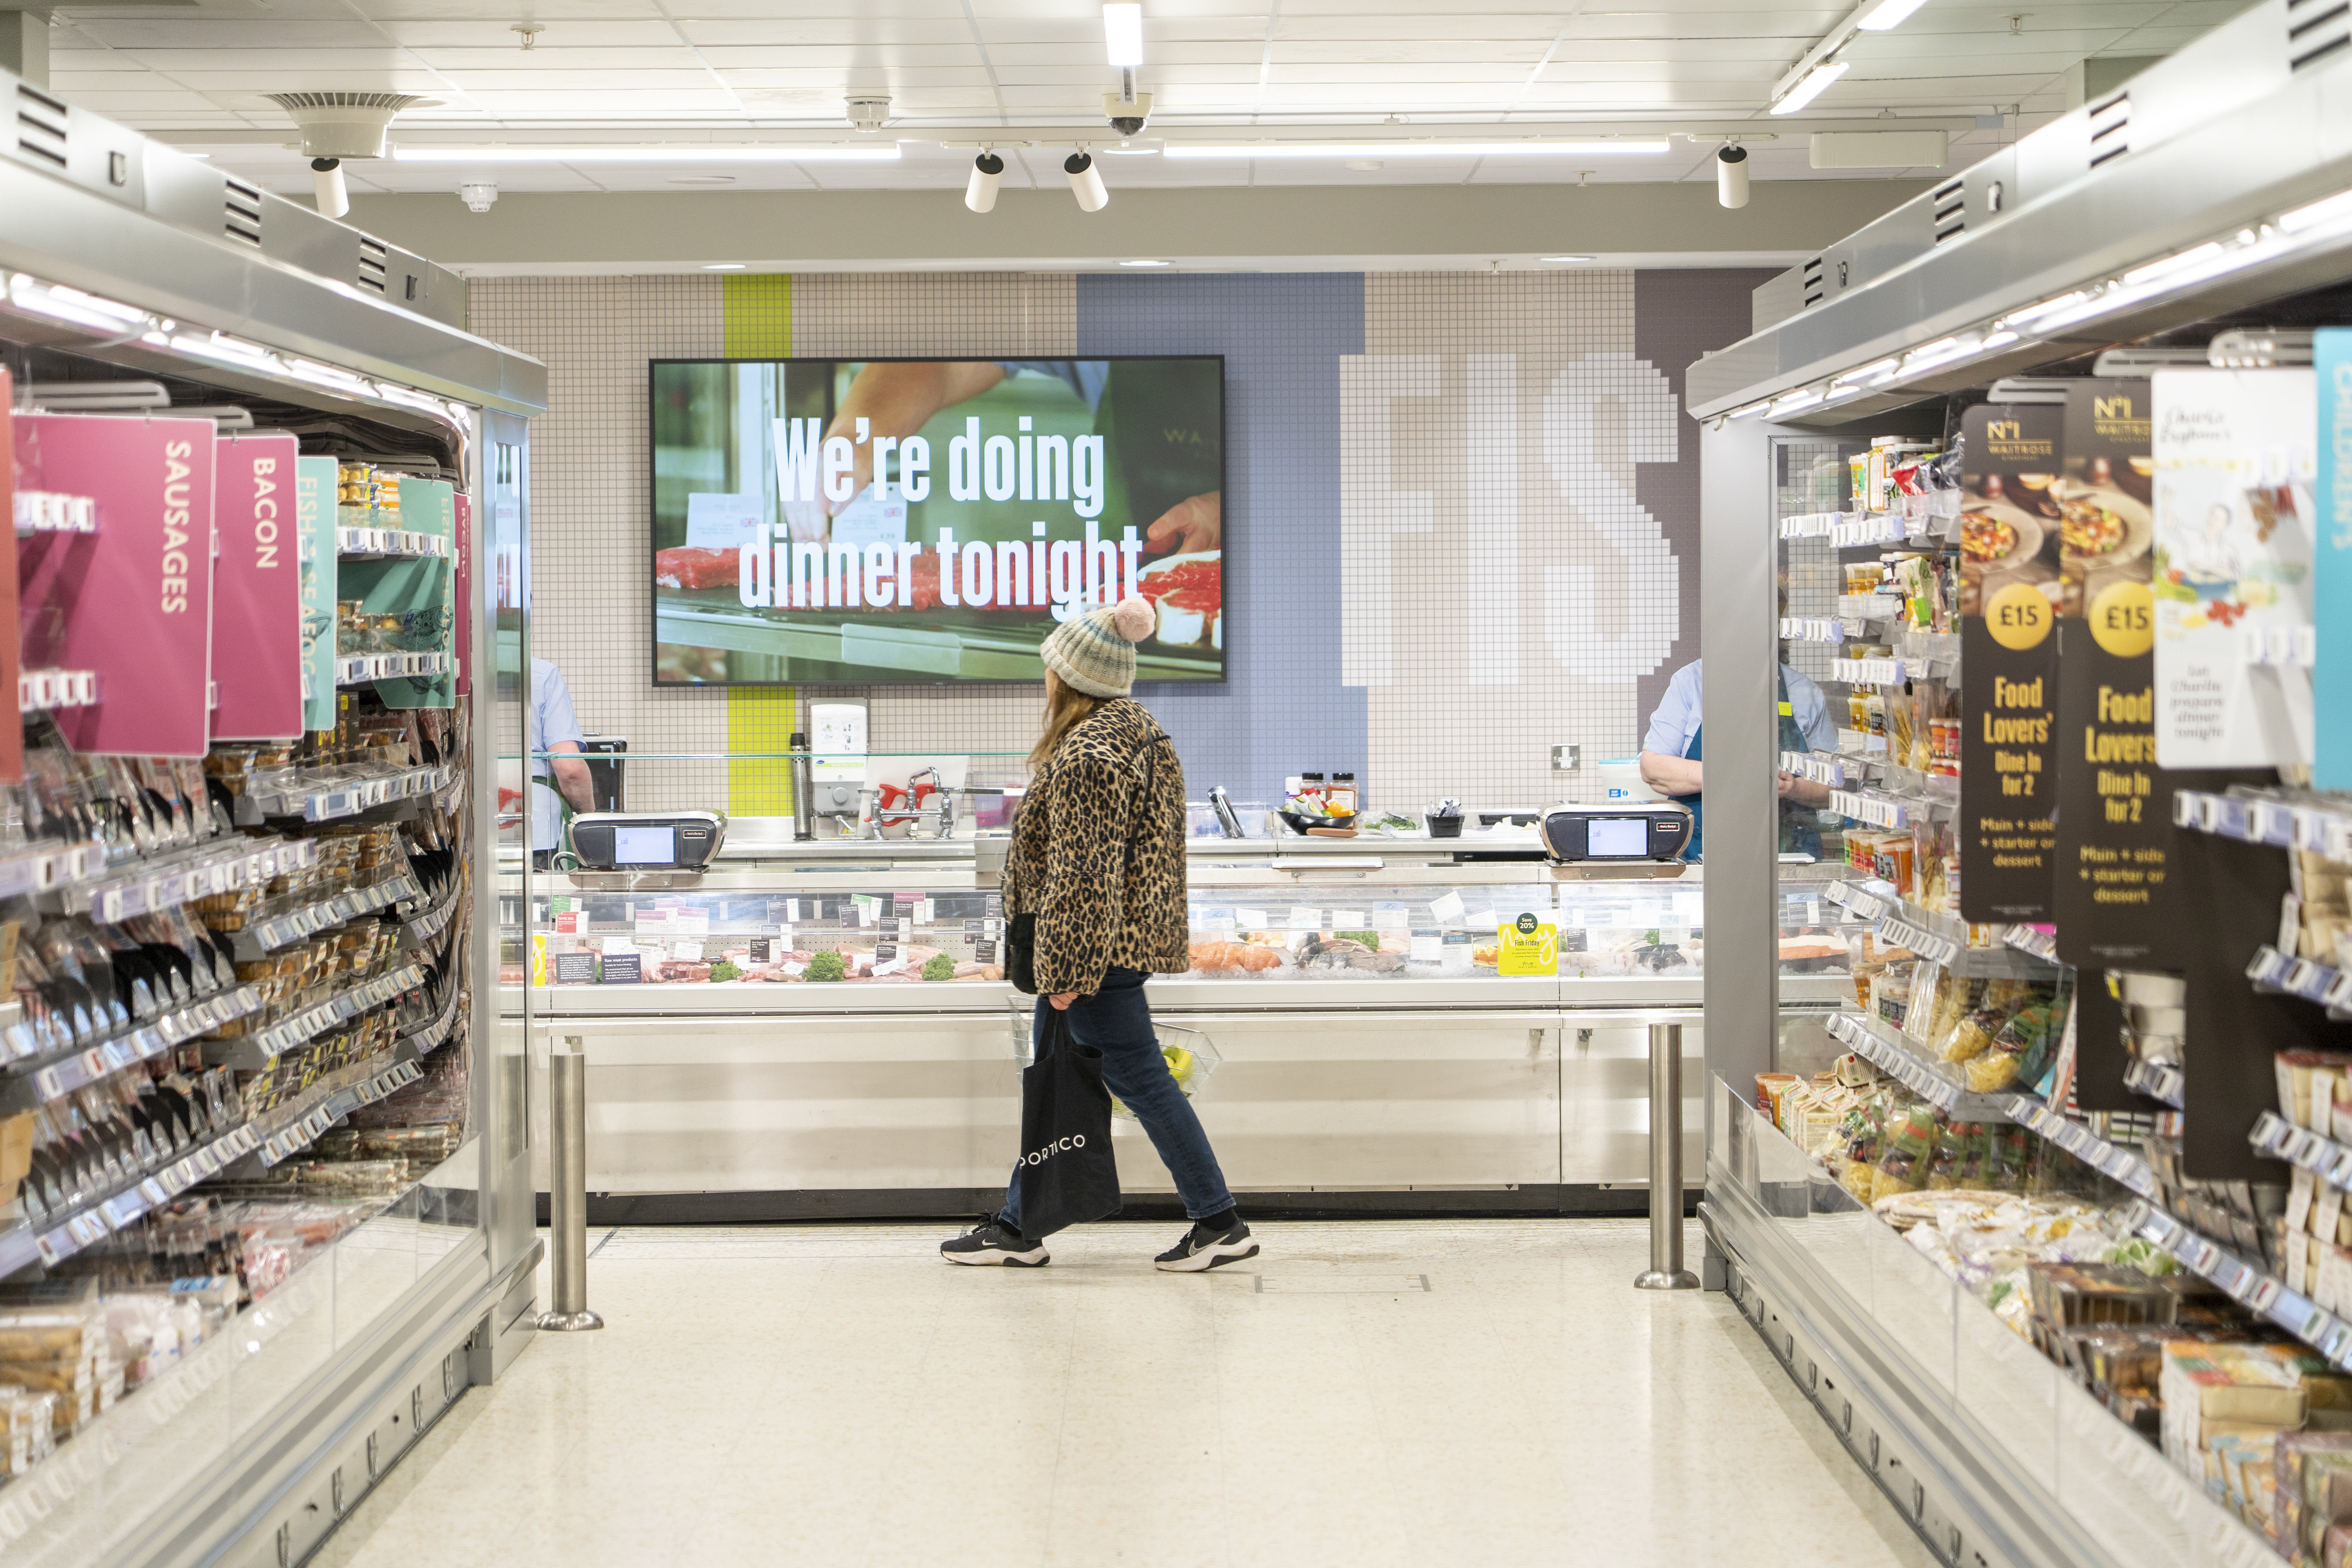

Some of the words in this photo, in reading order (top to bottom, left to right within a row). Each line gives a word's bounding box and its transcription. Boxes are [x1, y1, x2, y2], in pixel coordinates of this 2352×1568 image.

[2094, 425, 2151, 434] WAITRO
[1988, 446, 2052, 455] WAITROSE
[2332, 361, 2352, 550] CHILDRENS
[773, 416, 930, 502] We're
[949, 416, 1104, 518] doing
[254, 458, 278, 568] BACON
[299, 477, 318, 532] FISH
[161, 440, 191, 613] SAUSAGES
[1340, 353, 1679, 686] FIS
[739, 523, 921, 608] dinner
[936, 521, 1143, 622] tonight
[302, 572, 317, 674] SEAFOO
[2000, 605, 2038, 626] £15
[2106, 606, 2149, 629] £15
[1995, 676, 2043, 708] Food
[2098, 686, 2153, 723] Food
[2085, 725, 2156, 763] Lovers
[1995, 751, 2026, 772] Dine
[2027, 751, 2041, 773] In
[2002, 775, 2023, 795] for
[2024, 774, 2034, 796] 2
[2098, 770, 2132, 796] Dine
[2134, 770, 2151, 796] In
[2106, 797, 2130, 822] for
[2130, 797, 2142, 822] 2
[1981, 818, 2013, 831] Main
[2016, 820, 2024, 829] +
[2028, 818, 2055, 831] side
[1980, 838, 1990, 848] +
[1992, 836, 2036, 848] starter
[2040, 838, 2054, 848] or
[2080, 845, 2117, 862] Main
[2120, 850, 2130, 860] +
[2134, 847, 2165, 863] side
[1993, 855, 2041, 867] dessert
[2079, 870, 2090, 879] +
[2092, 868, 2144, 882] starter
[2147, 871, 2165, 882] or
[2093, 887, 2149, 903] dessert
[1020, 1134, 1085, 1169] PORTICO
